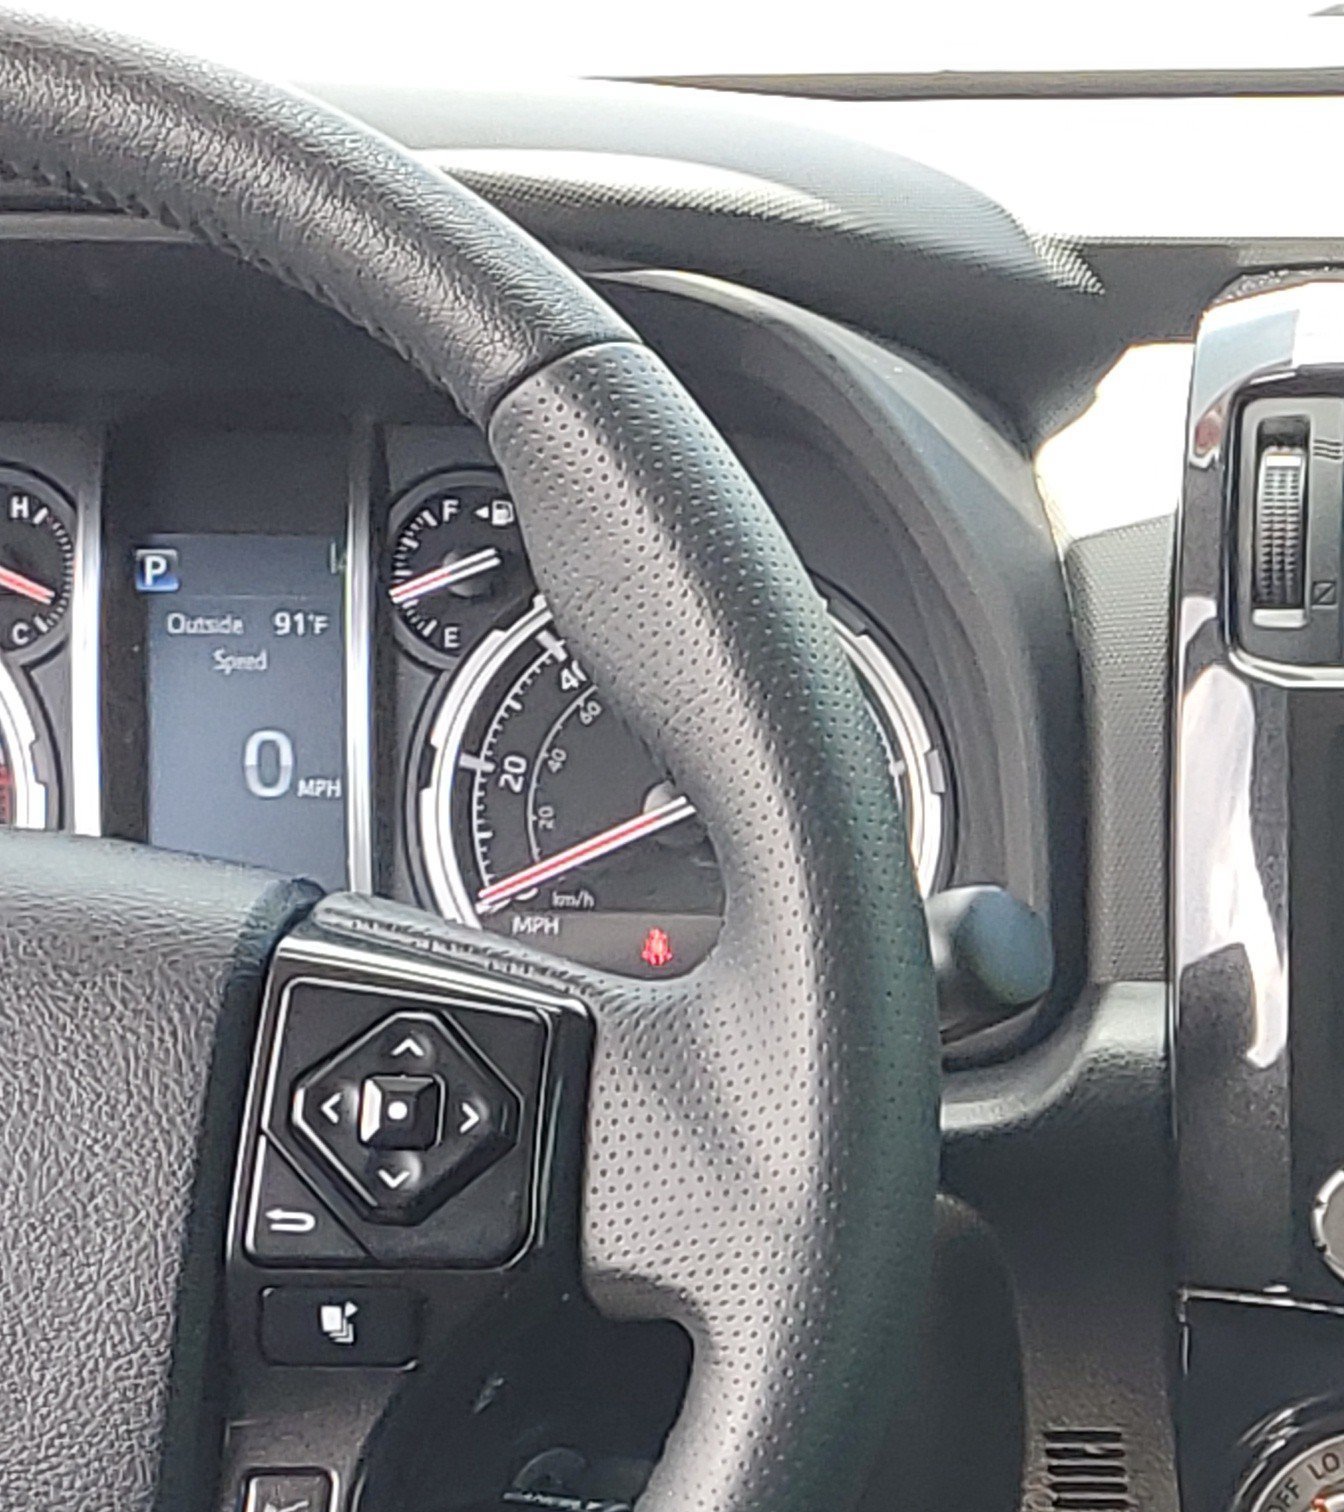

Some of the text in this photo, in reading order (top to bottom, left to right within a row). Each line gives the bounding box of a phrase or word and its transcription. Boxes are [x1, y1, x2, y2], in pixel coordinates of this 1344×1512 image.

[10, 497, 28, 518] H
[443, 500, 458, 521] F
[144, 556, 167, 586] P
[11, 622, 29, 645] C
[167, 613, 244, 634] Outside
[444, 627, 460, 648] E
[212, 648, 268, 675] Speed
[244, 729, 342, 798] 0 MPH
[548, 748, 567, 773] 40
[499, 755, 527, 792] 20
[538, 805, 554, 830] 20
[552, 890, 595, 909] km/h
[512, 916, 560, 935] MPH
[1306, 1452, 1340, 1480] LO
